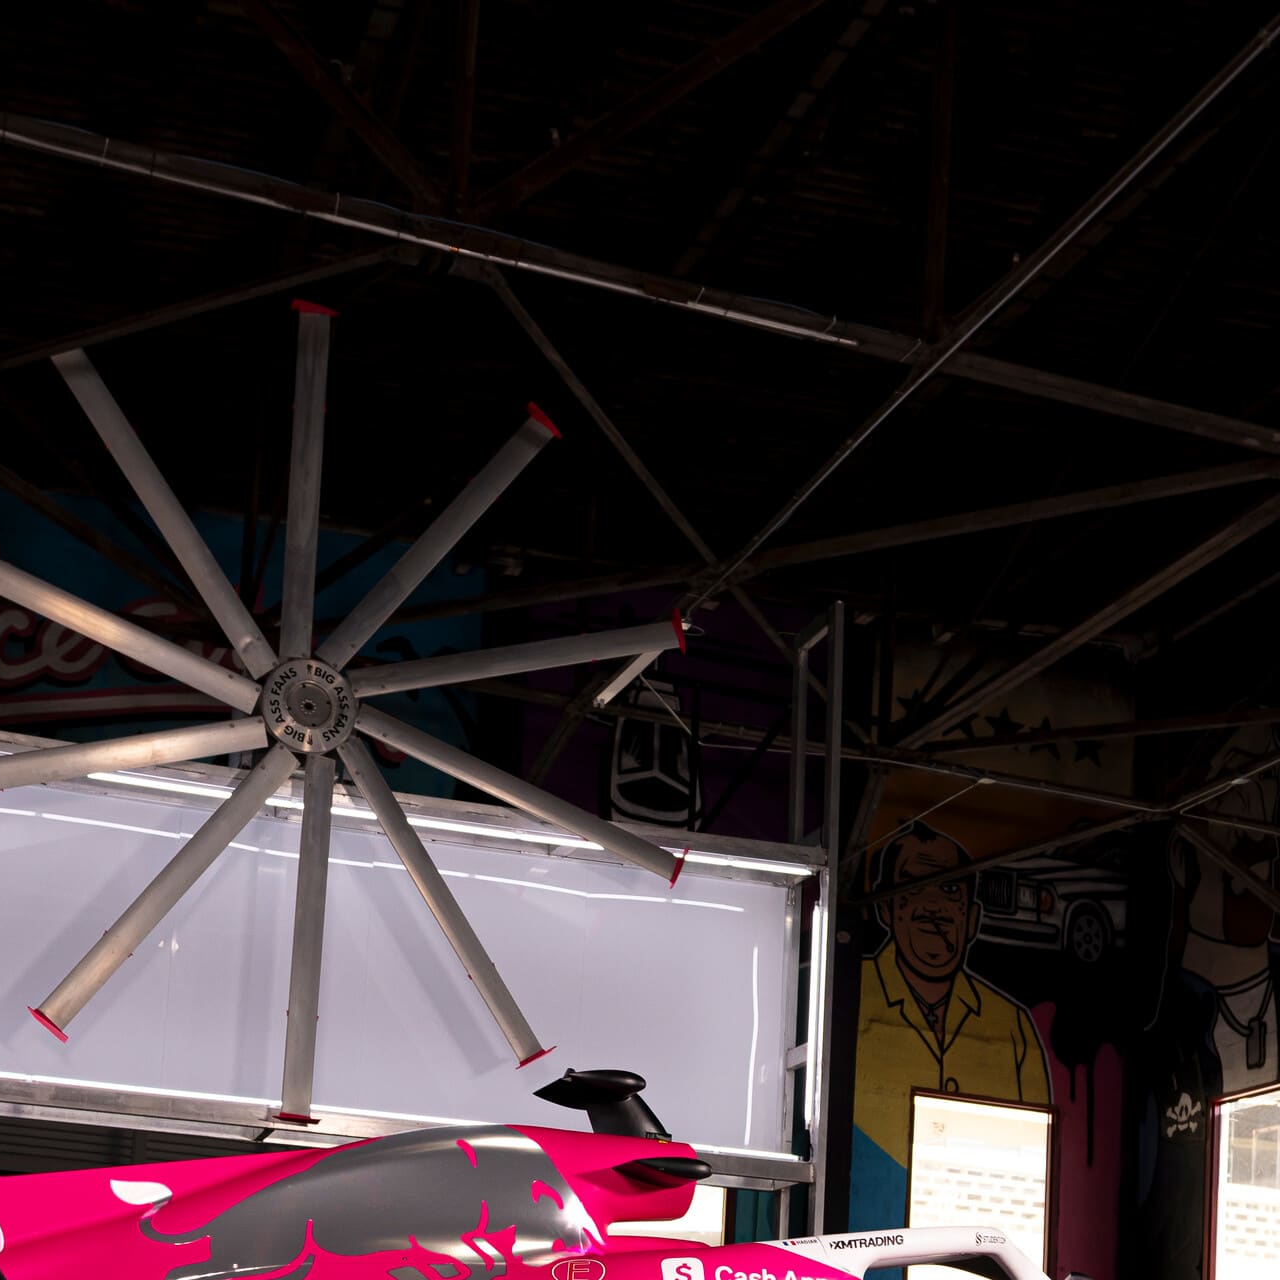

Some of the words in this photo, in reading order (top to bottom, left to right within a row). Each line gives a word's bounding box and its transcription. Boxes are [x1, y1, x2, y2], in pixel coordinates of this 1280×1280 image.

[271, 667, 297, 696] FANS
[314, 666, 335, 684] BIG
[333, 686, 349, 710] ASS
[269, 699, 285, 723] ASS
[283, 725, 306, 742] BIG
[322, 713, 348, 742] FANS
